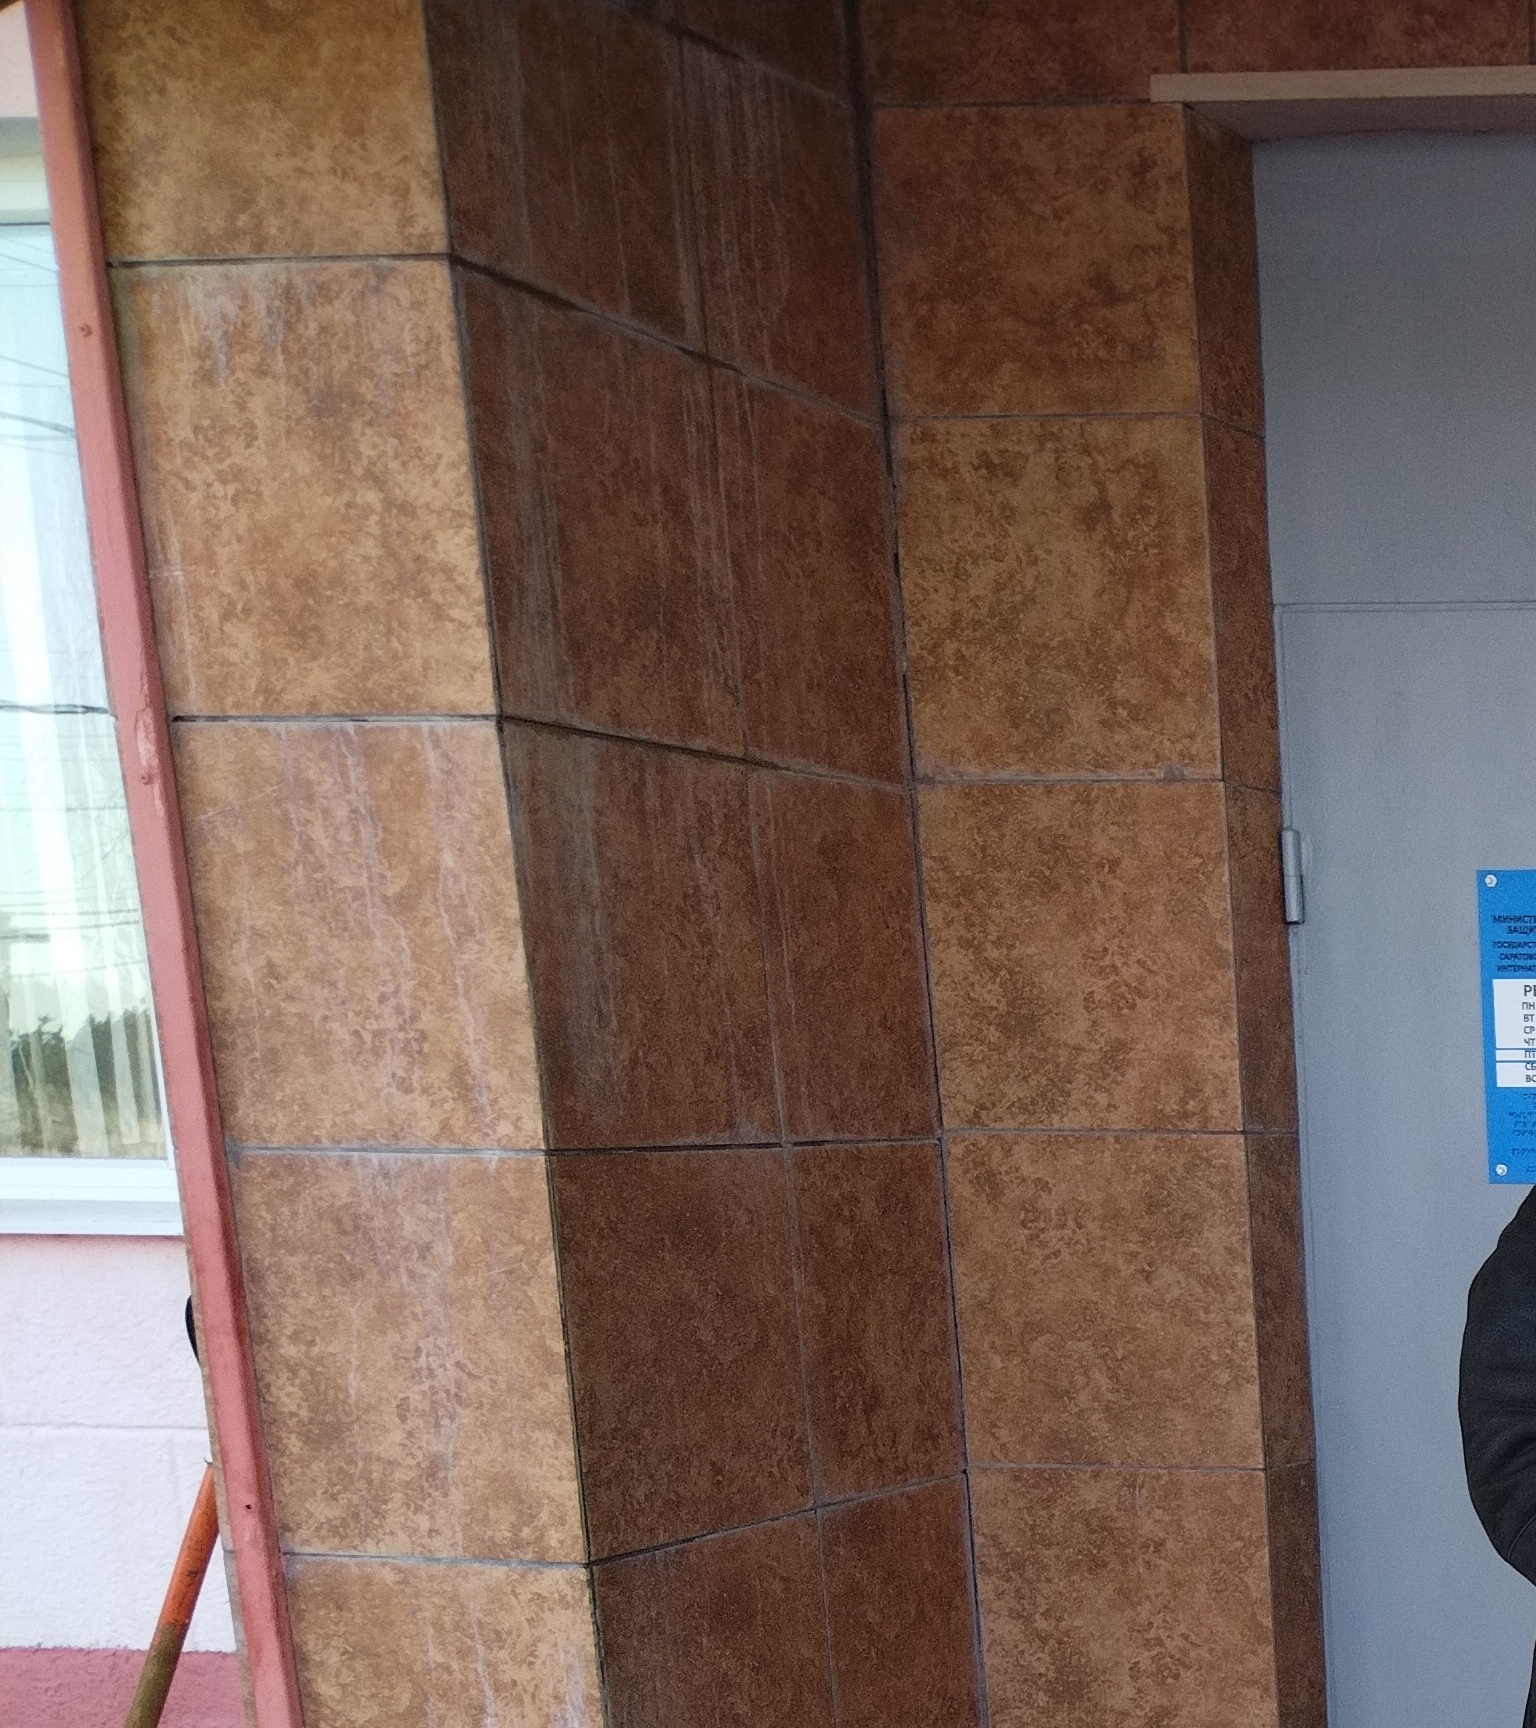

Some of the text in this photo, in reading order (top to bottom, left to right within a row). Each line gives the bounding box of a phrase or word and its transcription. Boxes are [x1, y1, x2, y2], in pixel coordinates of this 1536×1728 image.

[1521, 1002, 1535, 1010] ПН
[1523, 1014, 1535, 1022] ВТ
[1523, 1026, 1535, 1034] СР
[1523, 1038, 1536, 1046] ЧТ
[1524, 1050, 1536, 1058] ПТ
[1525, 1062, 1536, 1070] СБ
[1525, 1075, 1536, 1083] ВС
